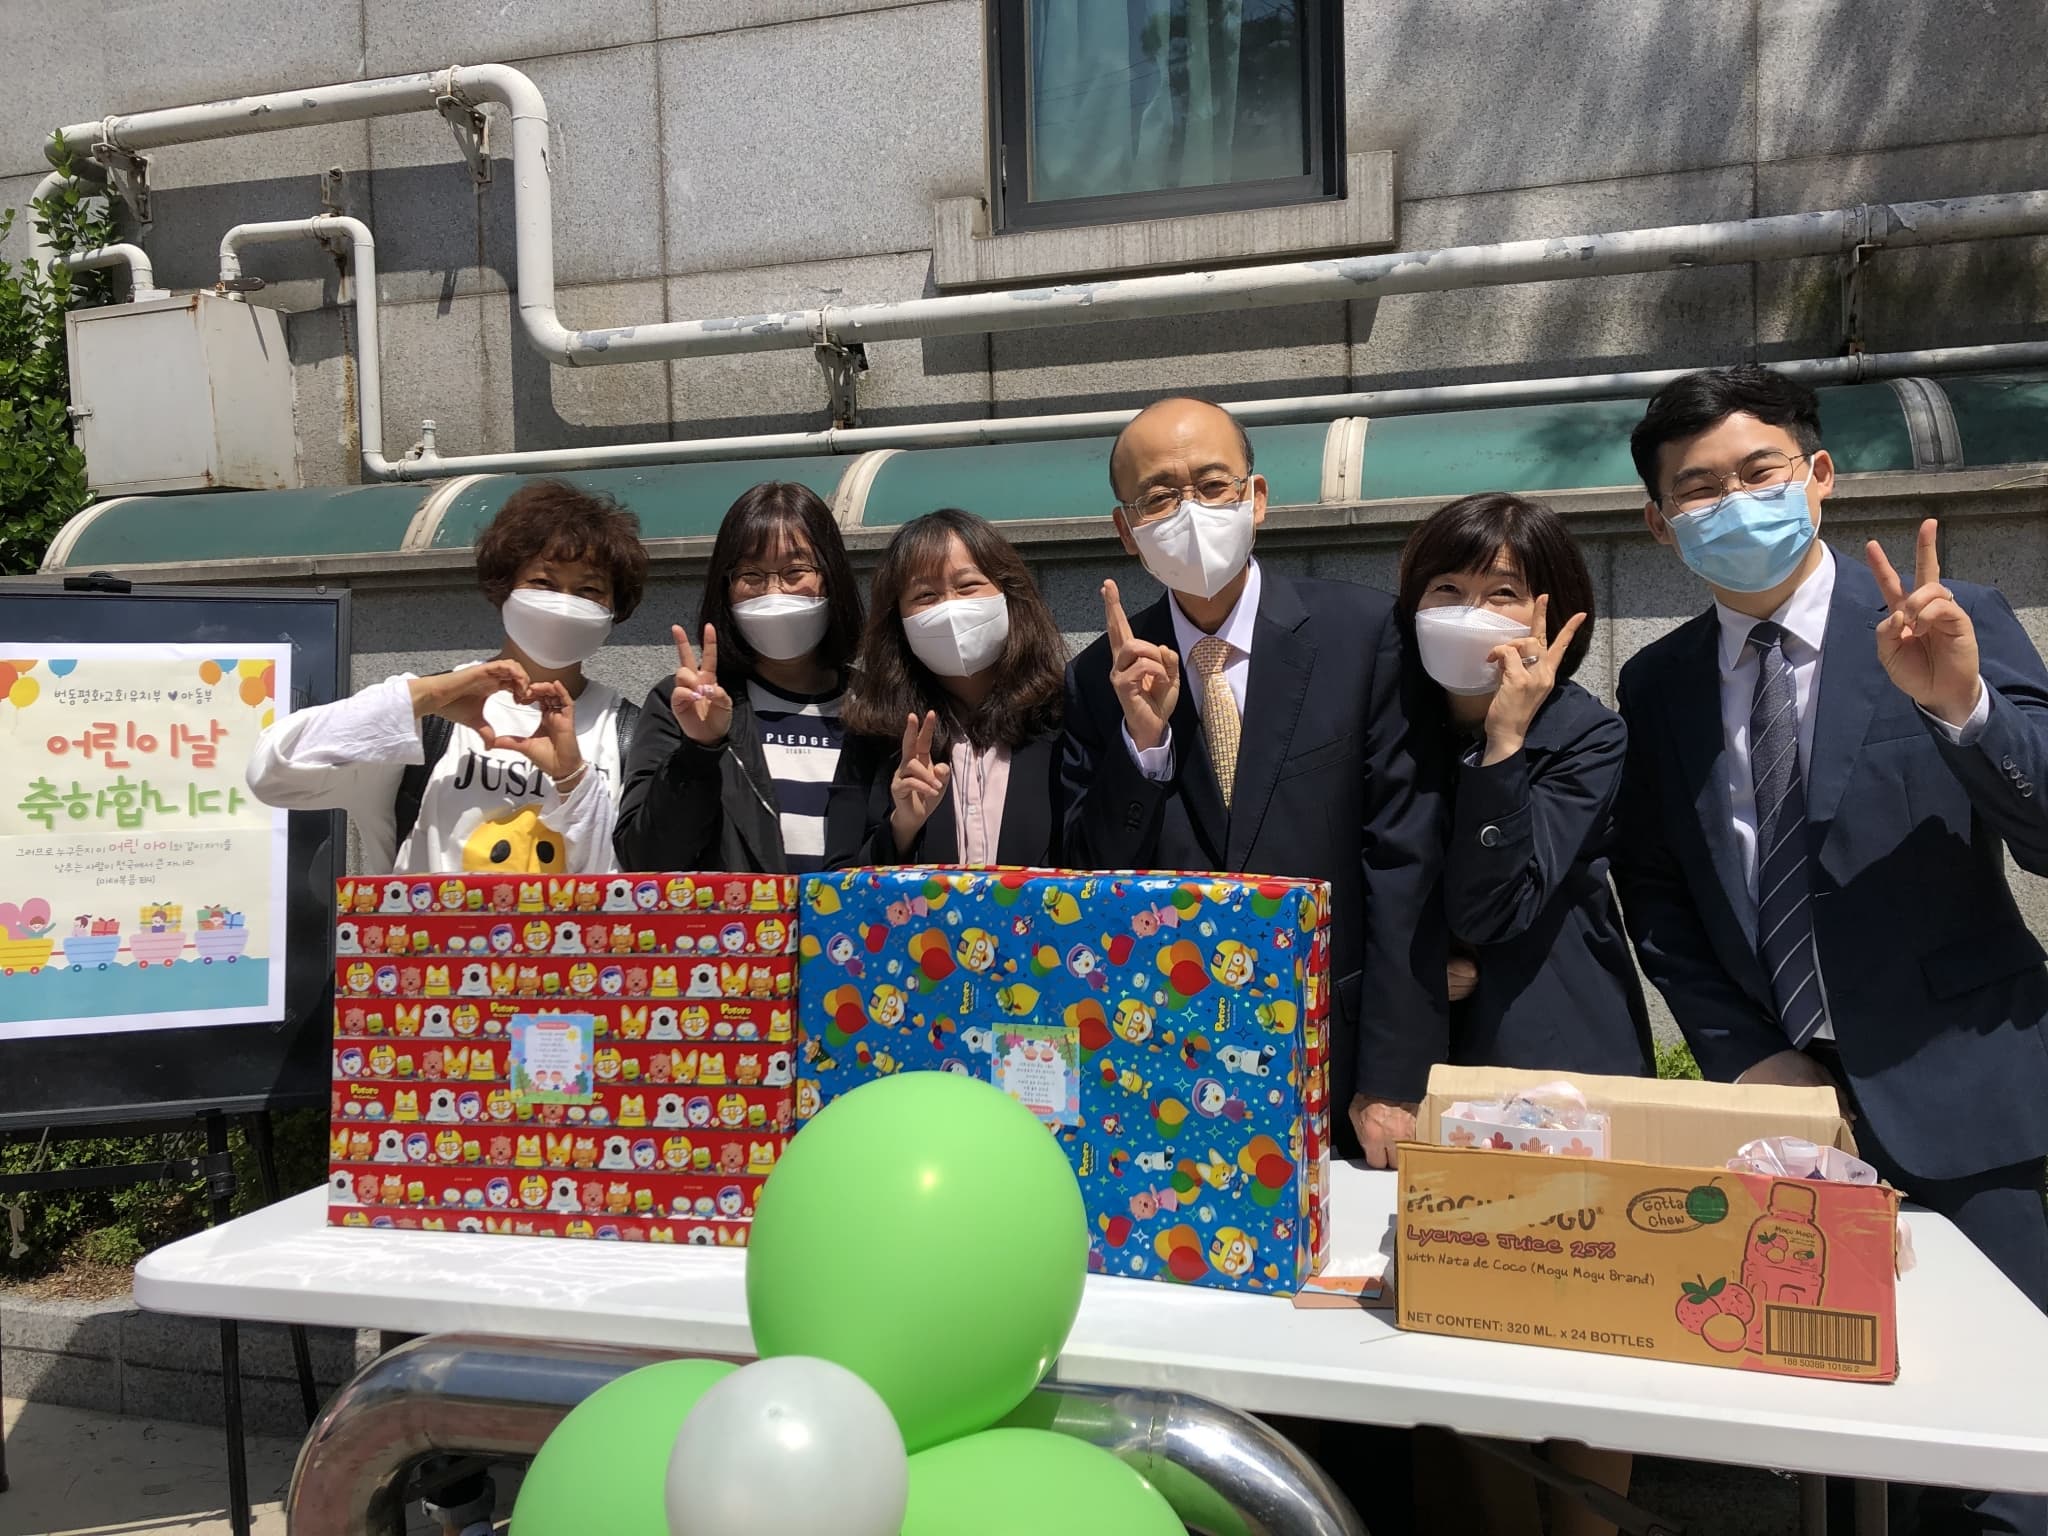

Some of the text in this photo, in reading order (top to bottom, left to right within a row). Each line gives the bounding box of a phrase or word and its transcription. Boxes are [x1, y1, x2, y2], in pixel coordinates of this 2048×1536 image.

[180, 688, 213, 704] 아동부
[47, 719, 229, 768] 어린이날
[766, 733, 830, 747] PLEDGE
[17, 775, 245, 829] 축하합니다
[108, 838, 139, 855] 어린
[1214, 996, 1226, 1032] Pororo
[1642, 1195, 1684, 1212] Gotta
[1648, 1212, 1685, 1228] Chew
[1496, 1233, 1563, 1253] Juice
[1570, 1240, 1616, 1259] 25%
[1407, 1252, 1655, 1286] with Nata de Coco (Mogu Mogu Brand)
[1407, 1311, 1432, 1323] NET
[1436, 1314, 1503, 1332] CONTENT:
[1507, 1321, 1531, 1334] 320
[1533, 1324, 1557, 1337] ML.
[1571, 1329, 1586, 1341] 24
[1590, 1331, 1655, 1349] BOTTLES
